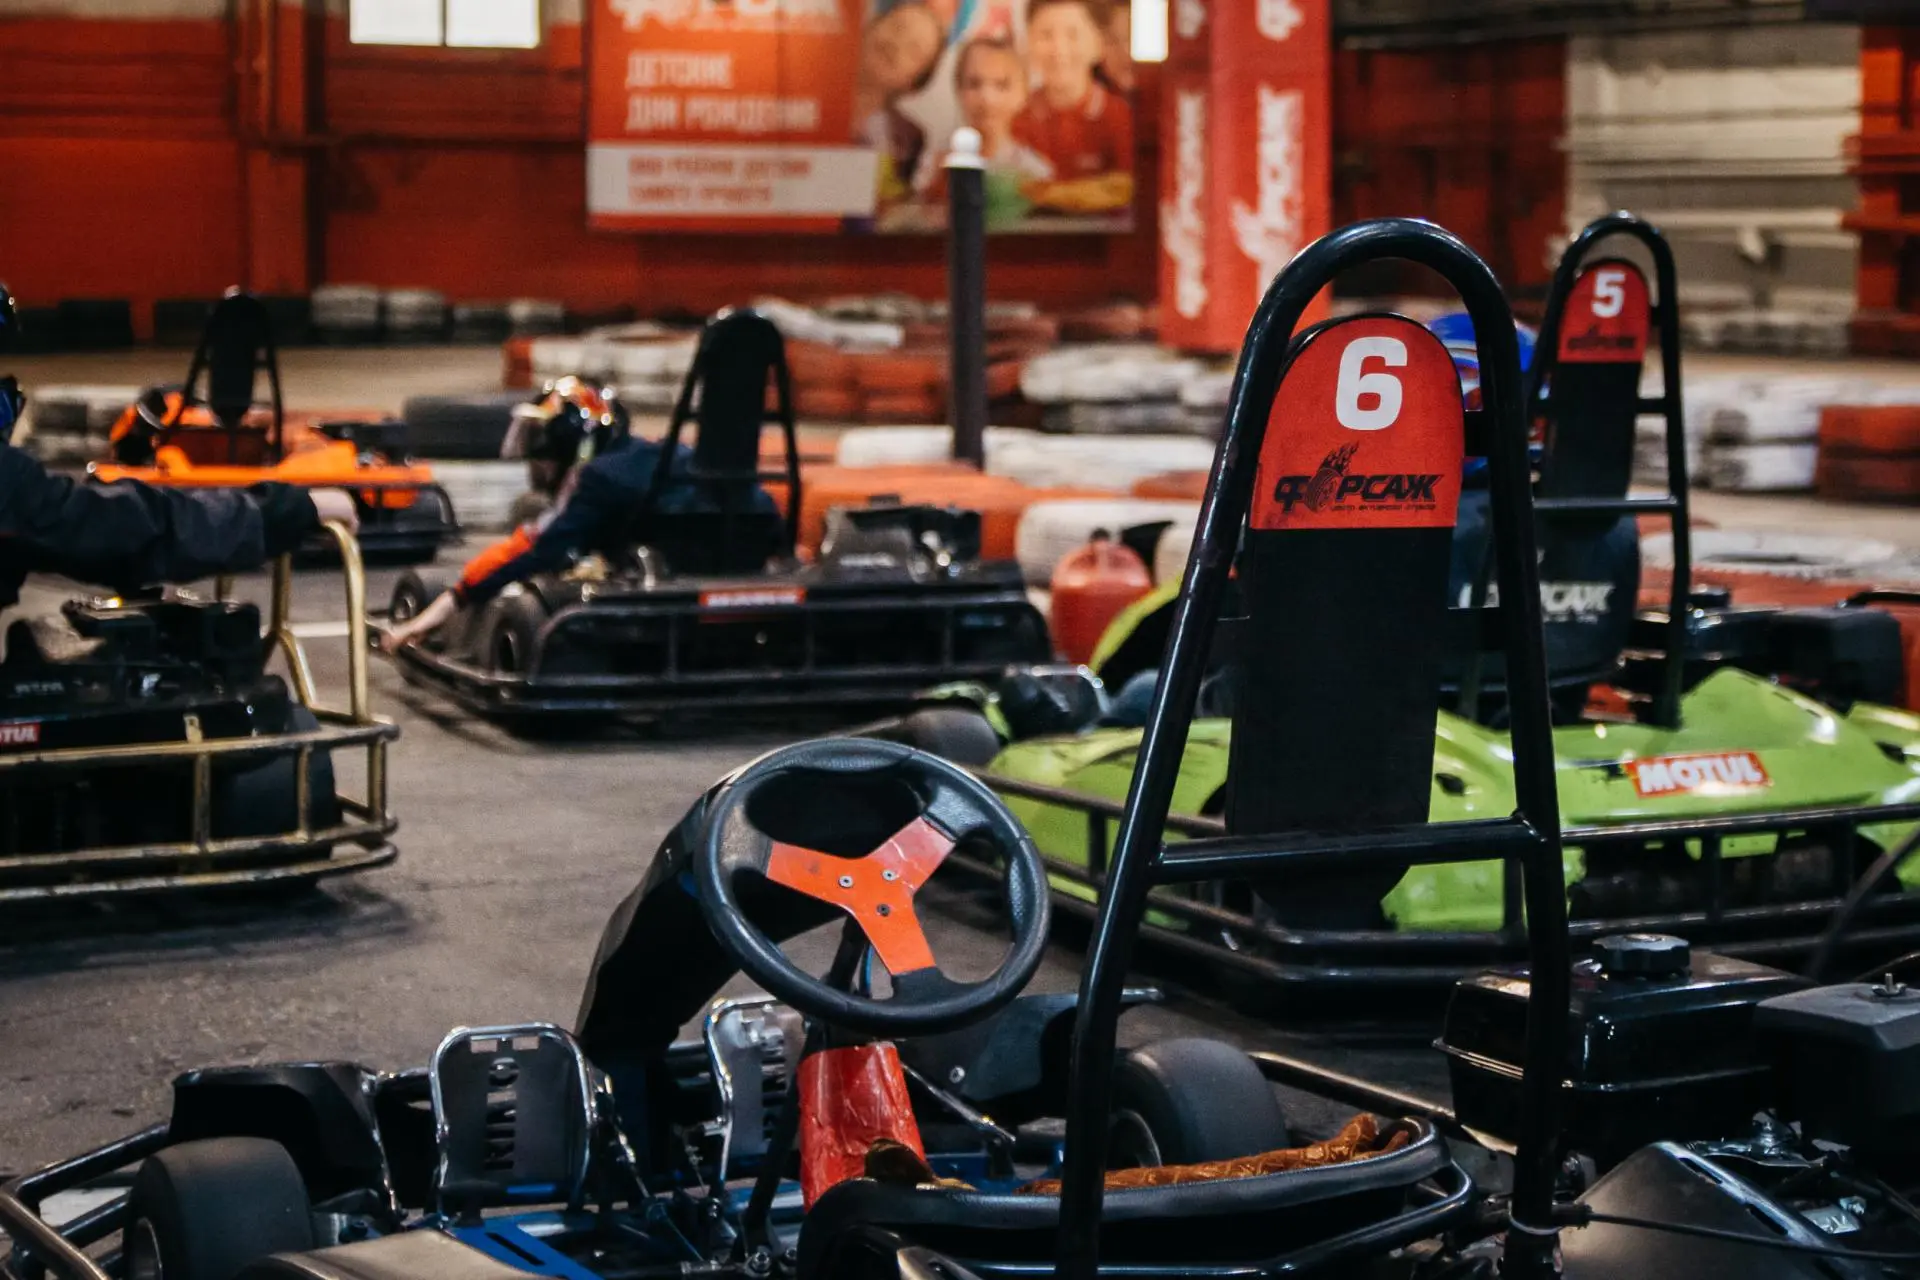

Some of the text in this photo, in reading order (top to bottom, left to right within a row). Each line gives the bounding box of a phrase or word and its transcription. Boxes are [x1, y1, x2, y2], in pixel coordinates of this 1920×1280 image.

[1591, 270, 1626, 318] 5
[1335, 336, 1408, 431] 6
[1637, 753, 1763, 794] MOTUL
